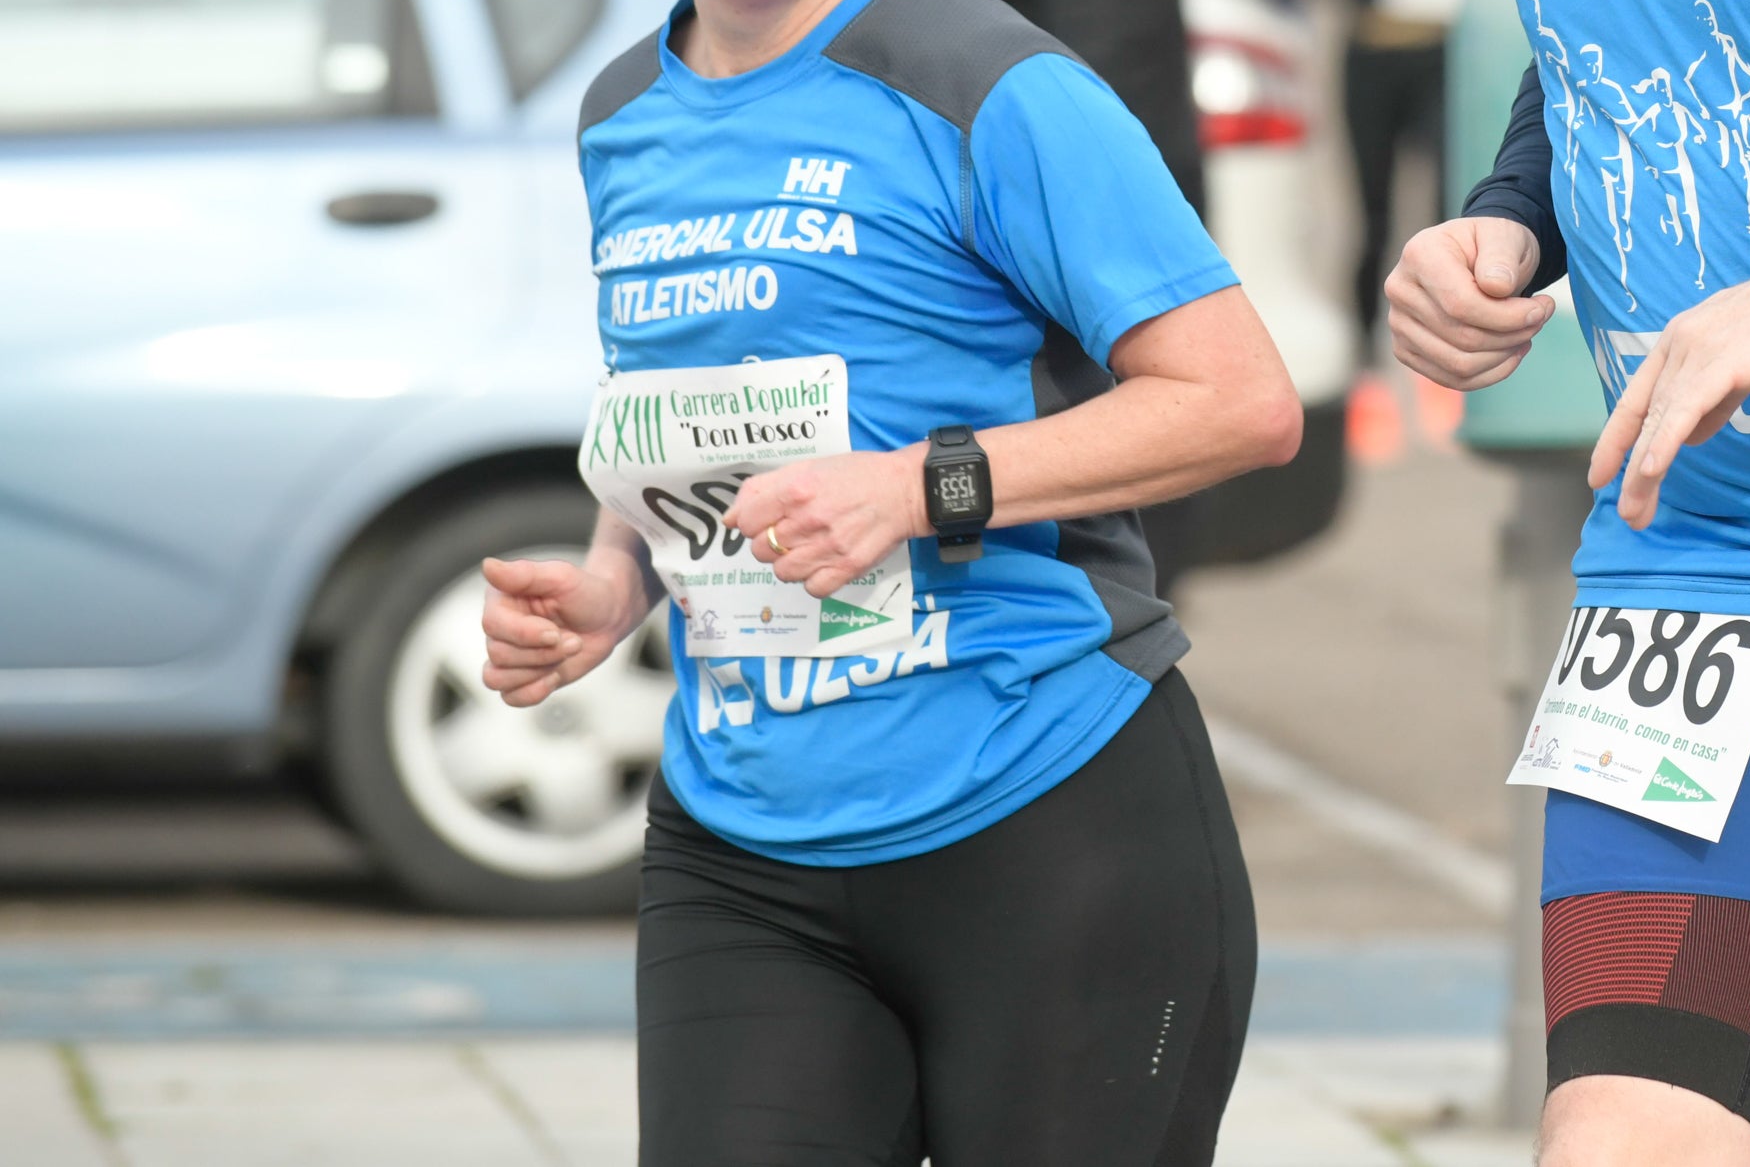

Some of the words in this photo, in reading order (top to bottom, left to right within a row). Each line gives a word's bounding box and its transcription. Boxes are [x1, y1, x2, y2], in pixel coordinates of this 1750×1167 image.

[783, 158, 846, 196] HH
[743, 208, 858, 255] ULSA
[611, 265, 778, 325] ATLETISMO
[671, 390, 740, 417] Carrera
[680, 422, 738, 448] "Don
[744, 410, 829, 444] Bosco"
[712, 573, 723, 585] en
[727, 570, 737, 585] el
[1565, 702, 1577, 715] en
[1578, 704, 1591, 720] el
[1591, 708, 1629, 734] barrio,
[1634, 723, 1671, 746] como
[1672, 737, 1689, 752] en
